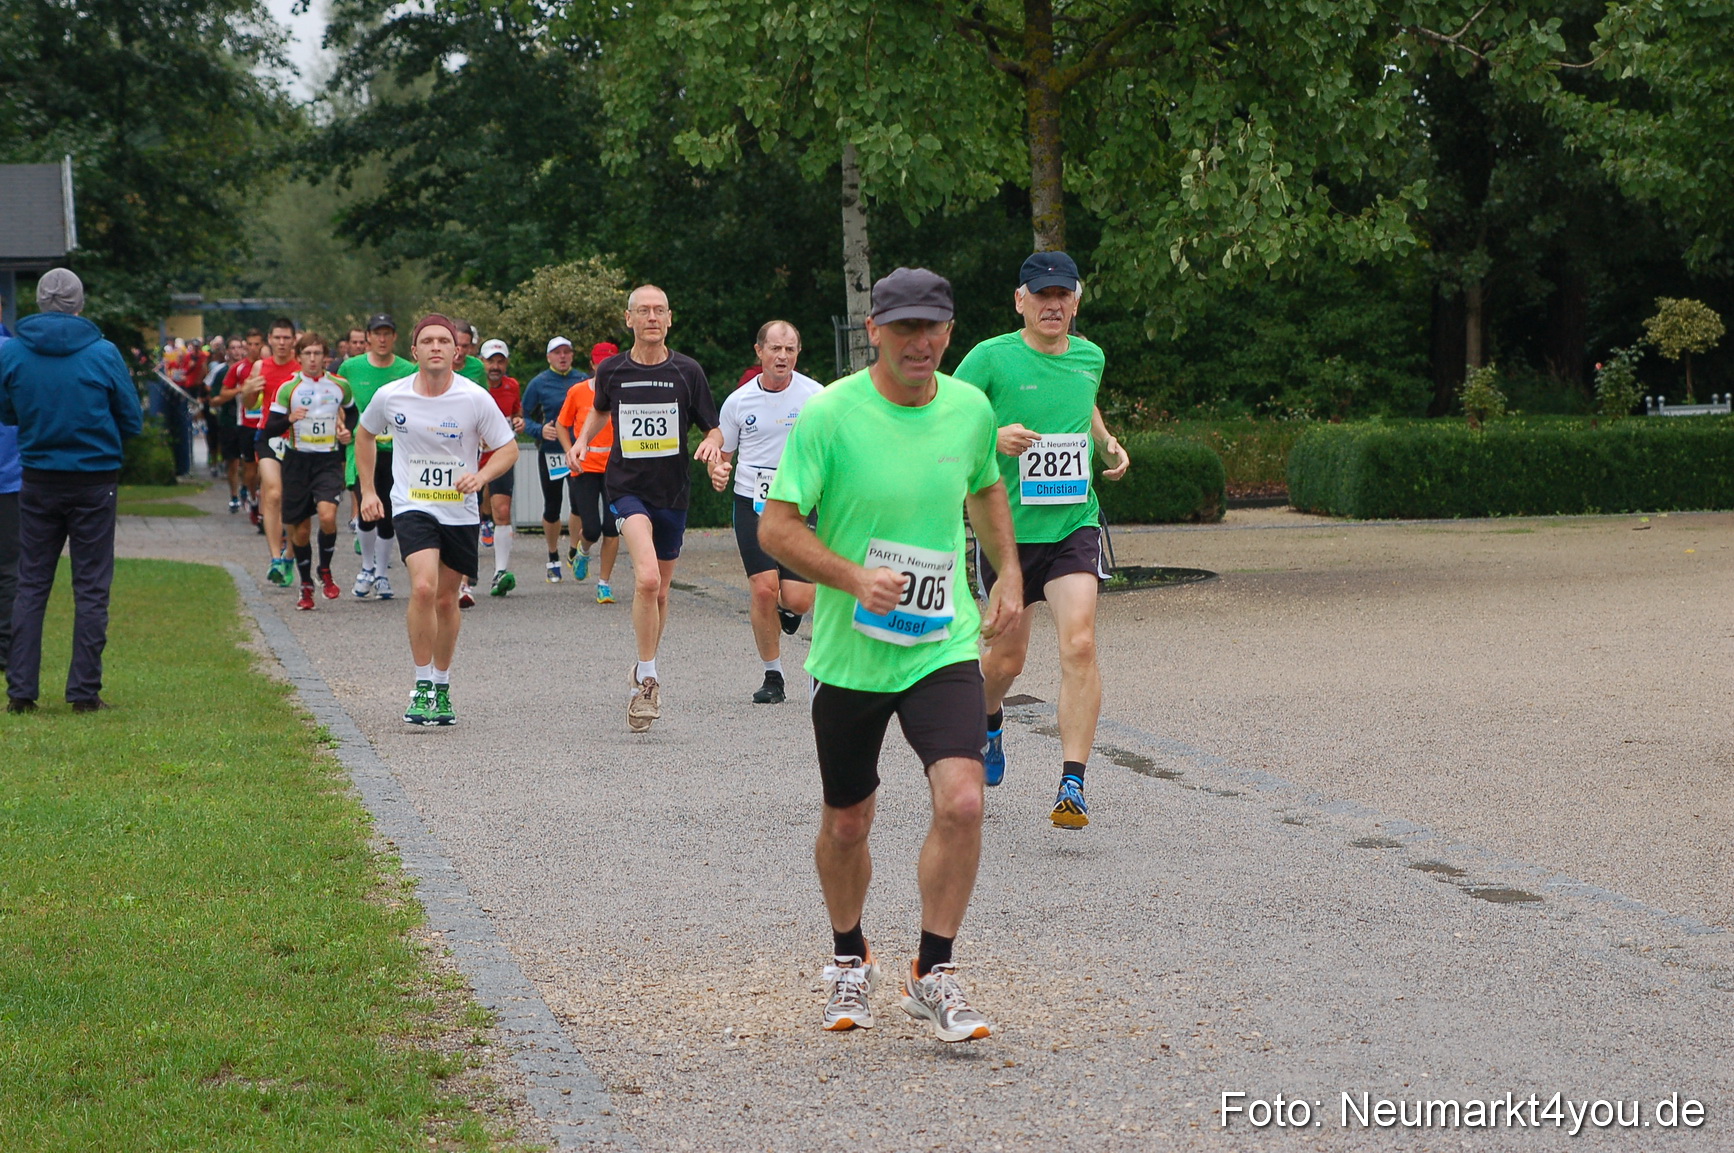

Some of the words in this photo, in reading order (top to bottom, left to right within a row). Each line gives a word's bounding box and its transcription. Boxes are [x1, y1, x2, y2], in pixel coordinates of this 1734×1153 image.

[312, 422, 326, 435] 61
[631, 417, 667, 437] 263
[1030, 441, 1046, 449] RTL
[550, 455, 564, 467] 31
[1027, 451, 1082, 477] 2821
[420, 467, 453, 487] 491
[411, 490, 461, 500] Hans-Christof
[760, 483, 770, 499] 3
[1036, 484, 1077, 495] Christian
[869, 548, 905, 564] PARTL
[885, 567, 946, 611] 905
[888, 615, 926, 634] Josef
